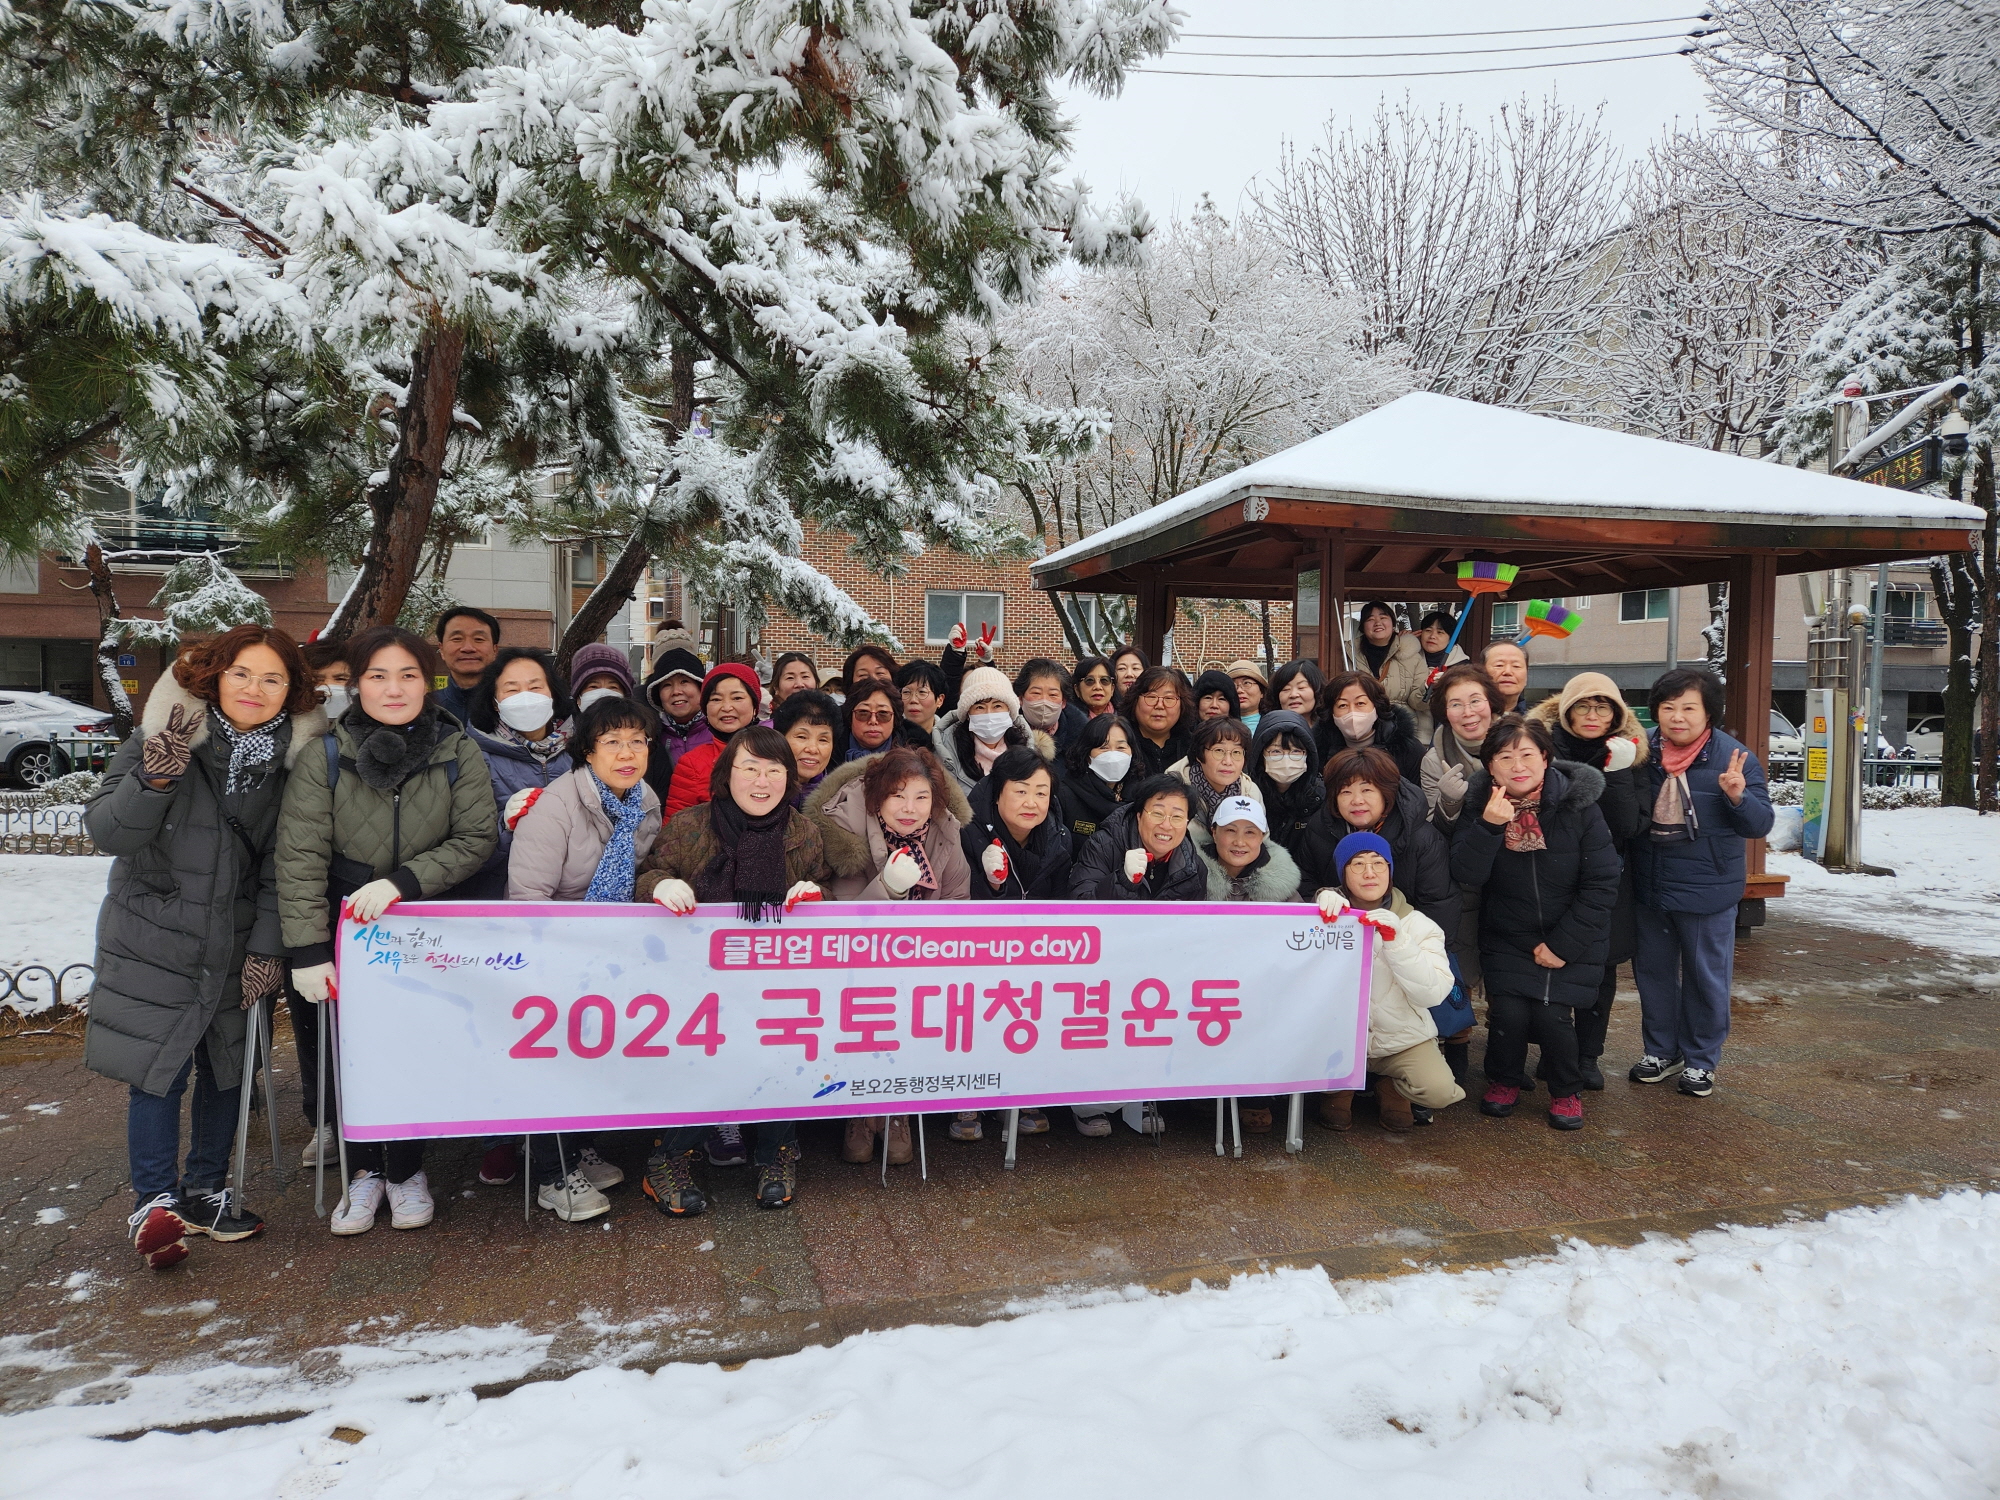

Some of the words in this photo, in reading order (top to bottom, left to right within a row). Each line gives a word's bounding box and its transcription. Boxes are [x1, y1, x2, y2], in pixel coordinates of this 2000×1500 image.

[353, 924, 404, 952] 시민과
[722, 934, 813, 965] 클린업
[821, 933, 1025, 963] 데이(Clean-up
[1030, 932, 1091, 962] day)
[367, 951, 419, 974] 자유로운
[424, 952, 480, 973] 혁신도시
[484, 952, 530, 970] 안산
[508, 992, 726, 1059] 2024
[755, 978, 1242, 1062] 국토대청결운동
[849, 1072, 1002, 1097] 본오2동행정복지센터
